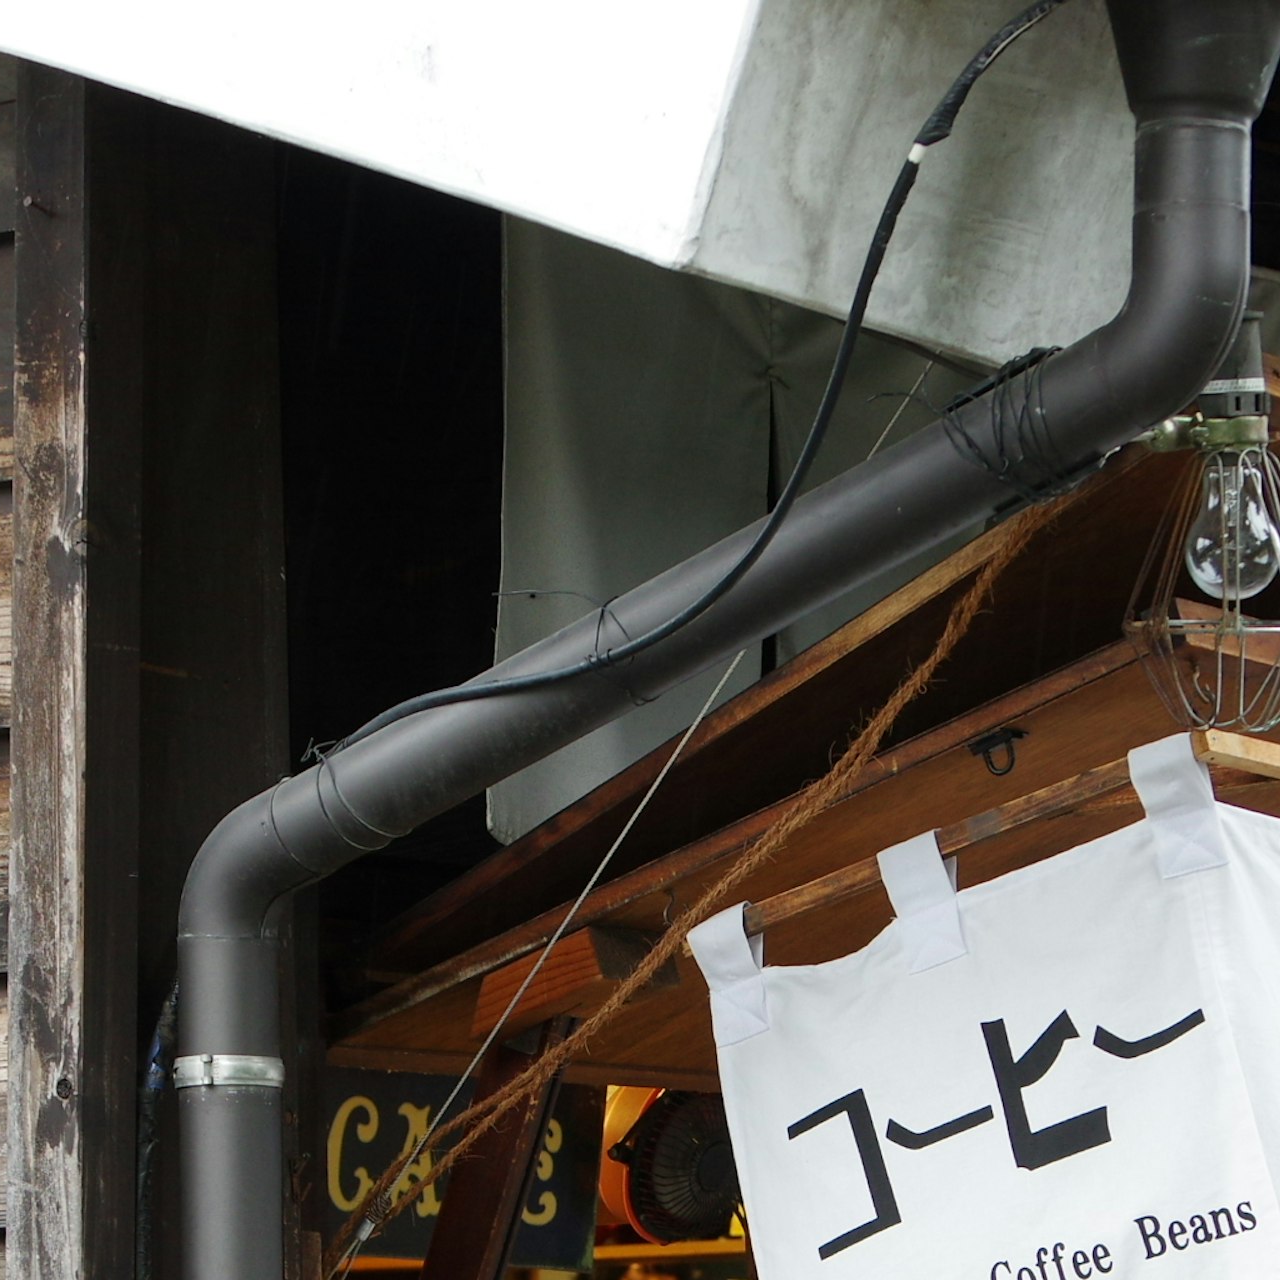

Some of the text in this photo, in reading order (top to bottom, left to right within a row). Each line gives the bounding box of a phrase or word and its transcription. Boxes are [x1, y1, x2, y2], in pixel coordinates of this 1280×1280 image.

[787, 1008, 1206, 1261] コーヒー
[1133, 1200, 1258, 1261] Beans
